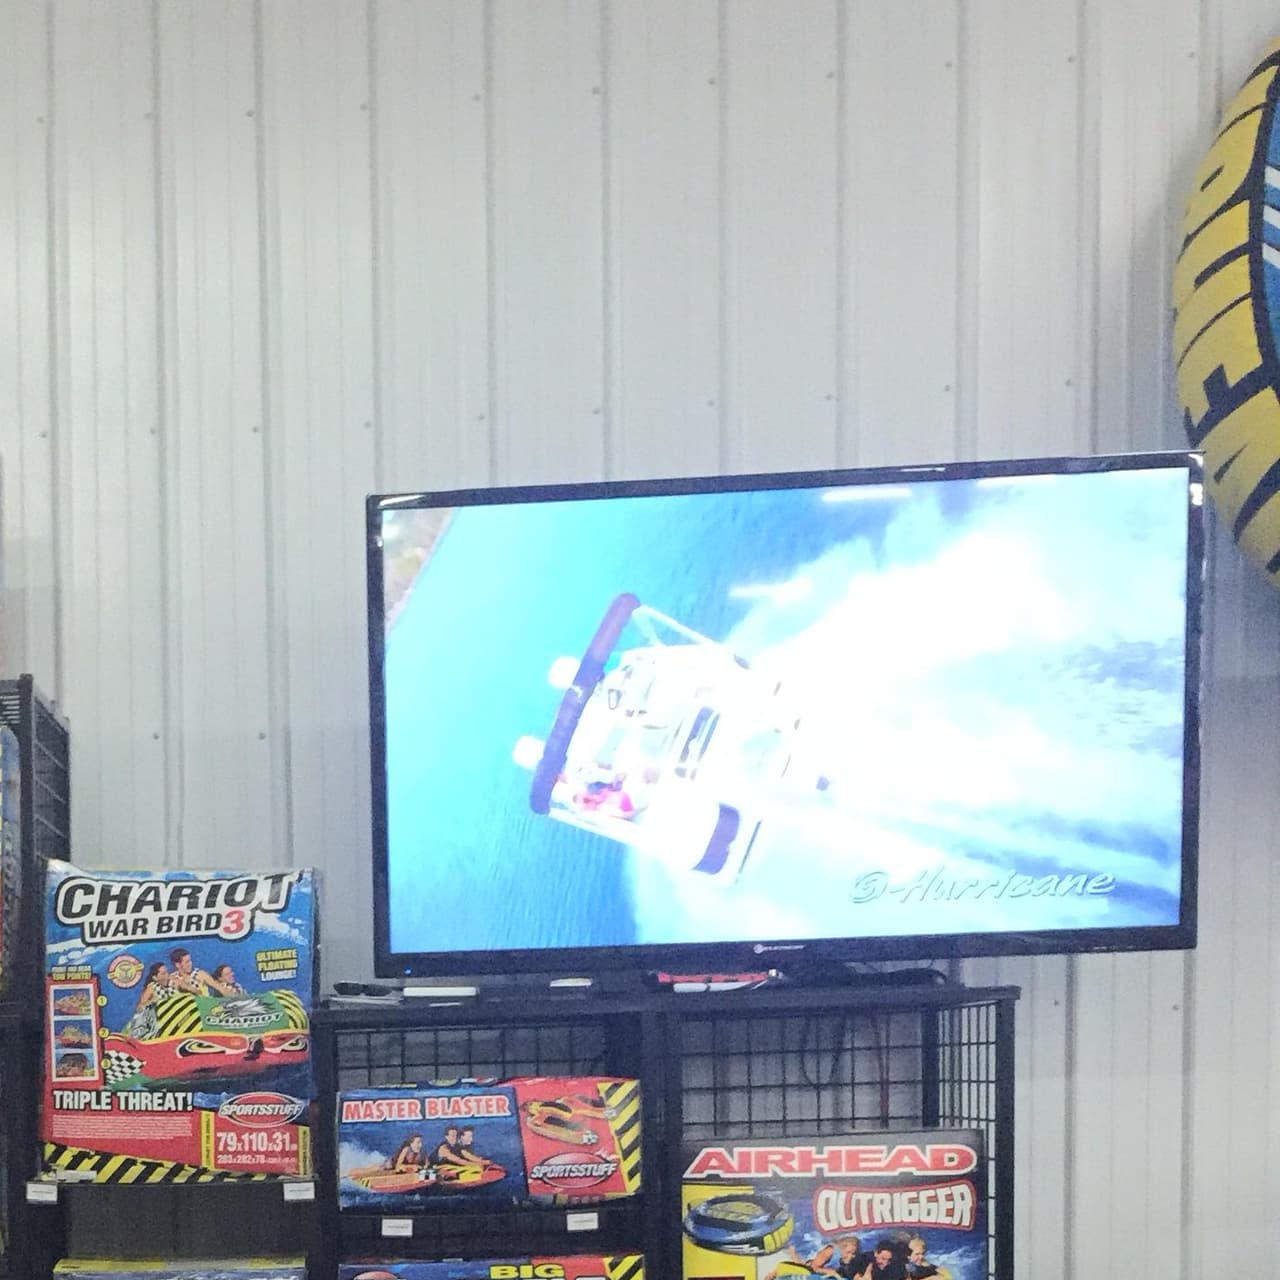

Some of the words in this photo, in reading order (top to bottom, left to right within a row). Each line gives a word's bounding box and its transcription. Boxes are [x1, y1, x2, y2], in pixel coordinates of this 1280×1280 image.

[57, 873, 302, 925] CHARIOT
[87, 918, 149, 939] WAR
[53, 1091, 112, 1111] TRIPLE
[117, 1092, 193, 1112] THREAT!
[219, 1104, 303, 1117] SPORTSSTUFF
[342, 1099, 423, 1123] MASTER
[425, 1096, 511, 1119] BLASTER
[531, 1162, 617, 1180] SPORTSSTUFF
[683, 1144, 977, 1179] AIRHEAD
[816, 1184, 973, 1230] OUTRIGGER
[489, 1264, 564, 1280] BIG
